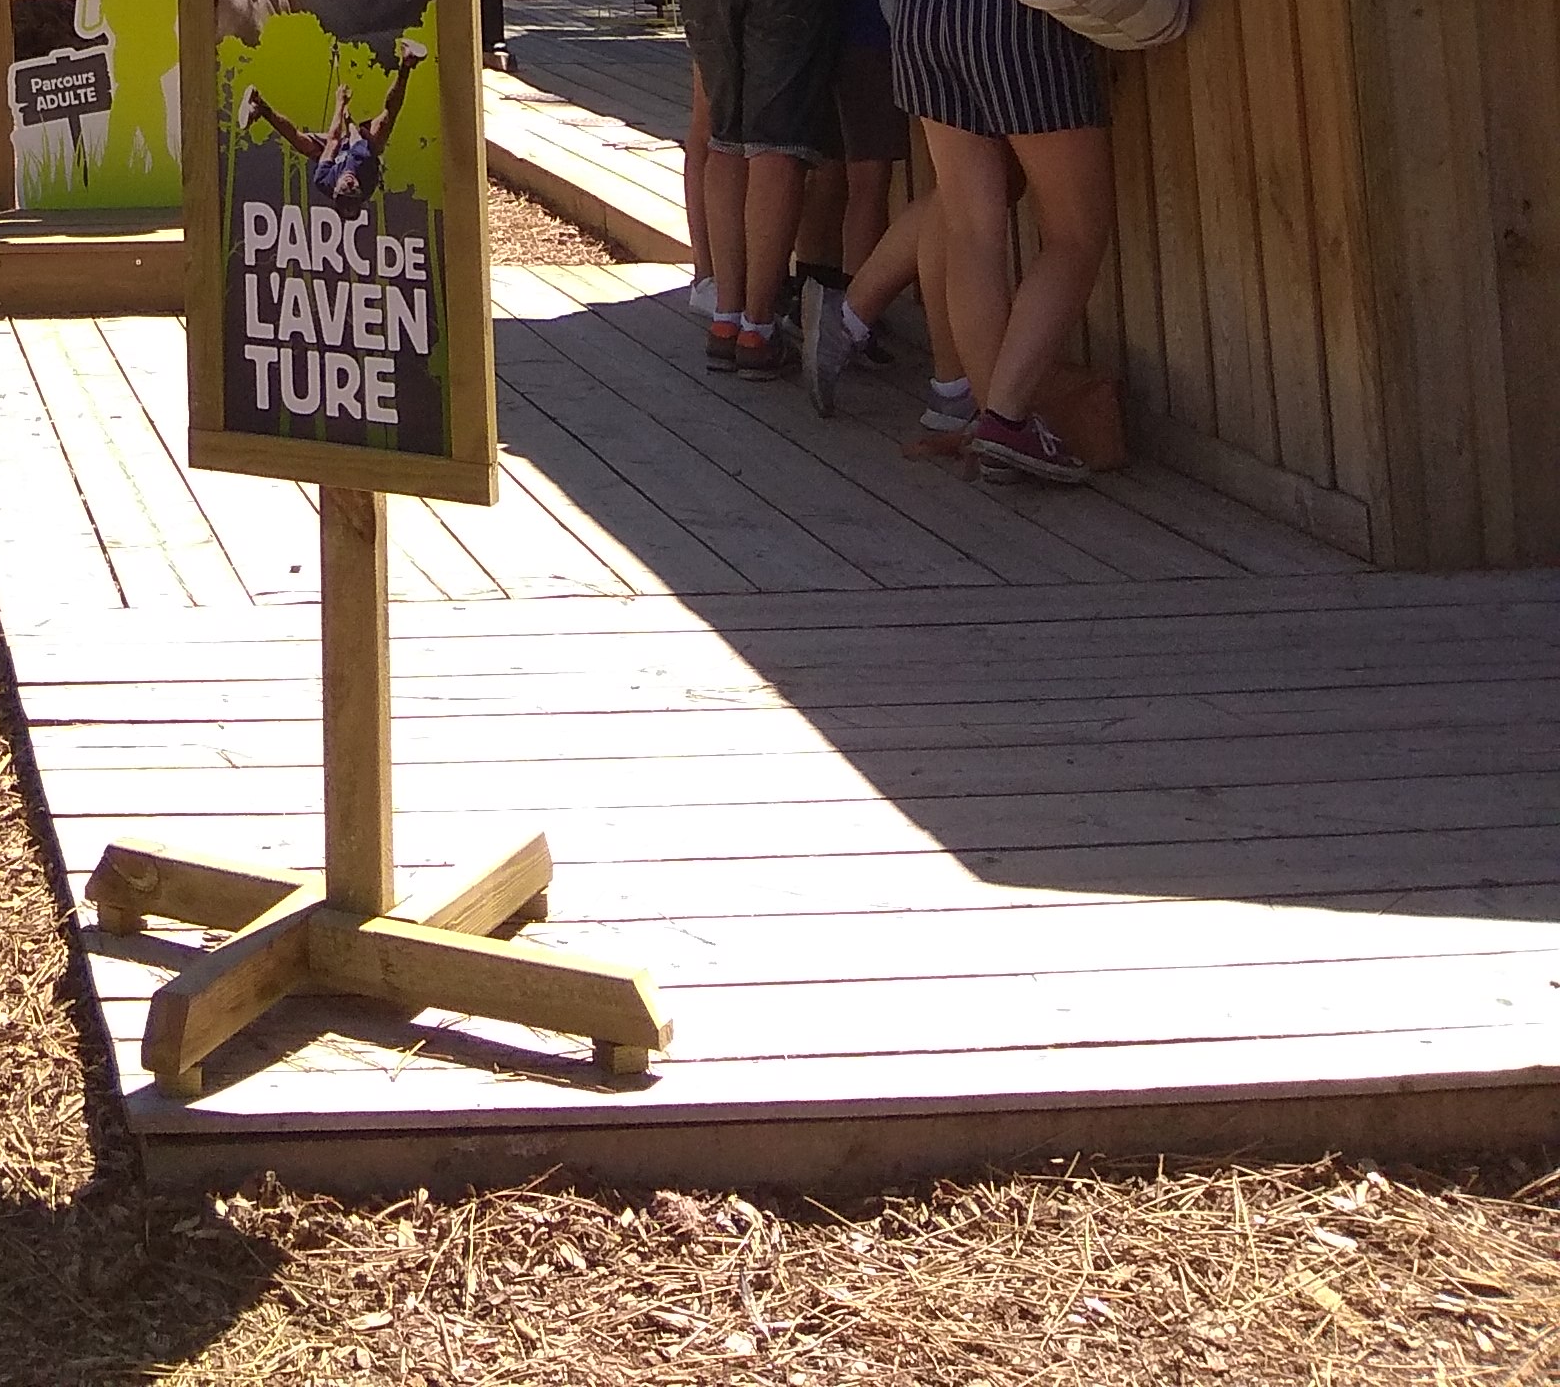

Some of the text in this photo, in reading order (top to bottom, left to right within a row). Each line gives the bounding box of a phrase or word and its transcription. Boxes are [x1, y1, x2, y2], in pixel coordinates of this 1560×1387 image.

[30, 72, 96, 93] Parcours
[36, 87, 97, 111] ADULTE
[242, 201, 427, 281] PARC DE
[243, 272, 429, 355] L'AVEN
[243, 344, 400, 424] TURE
